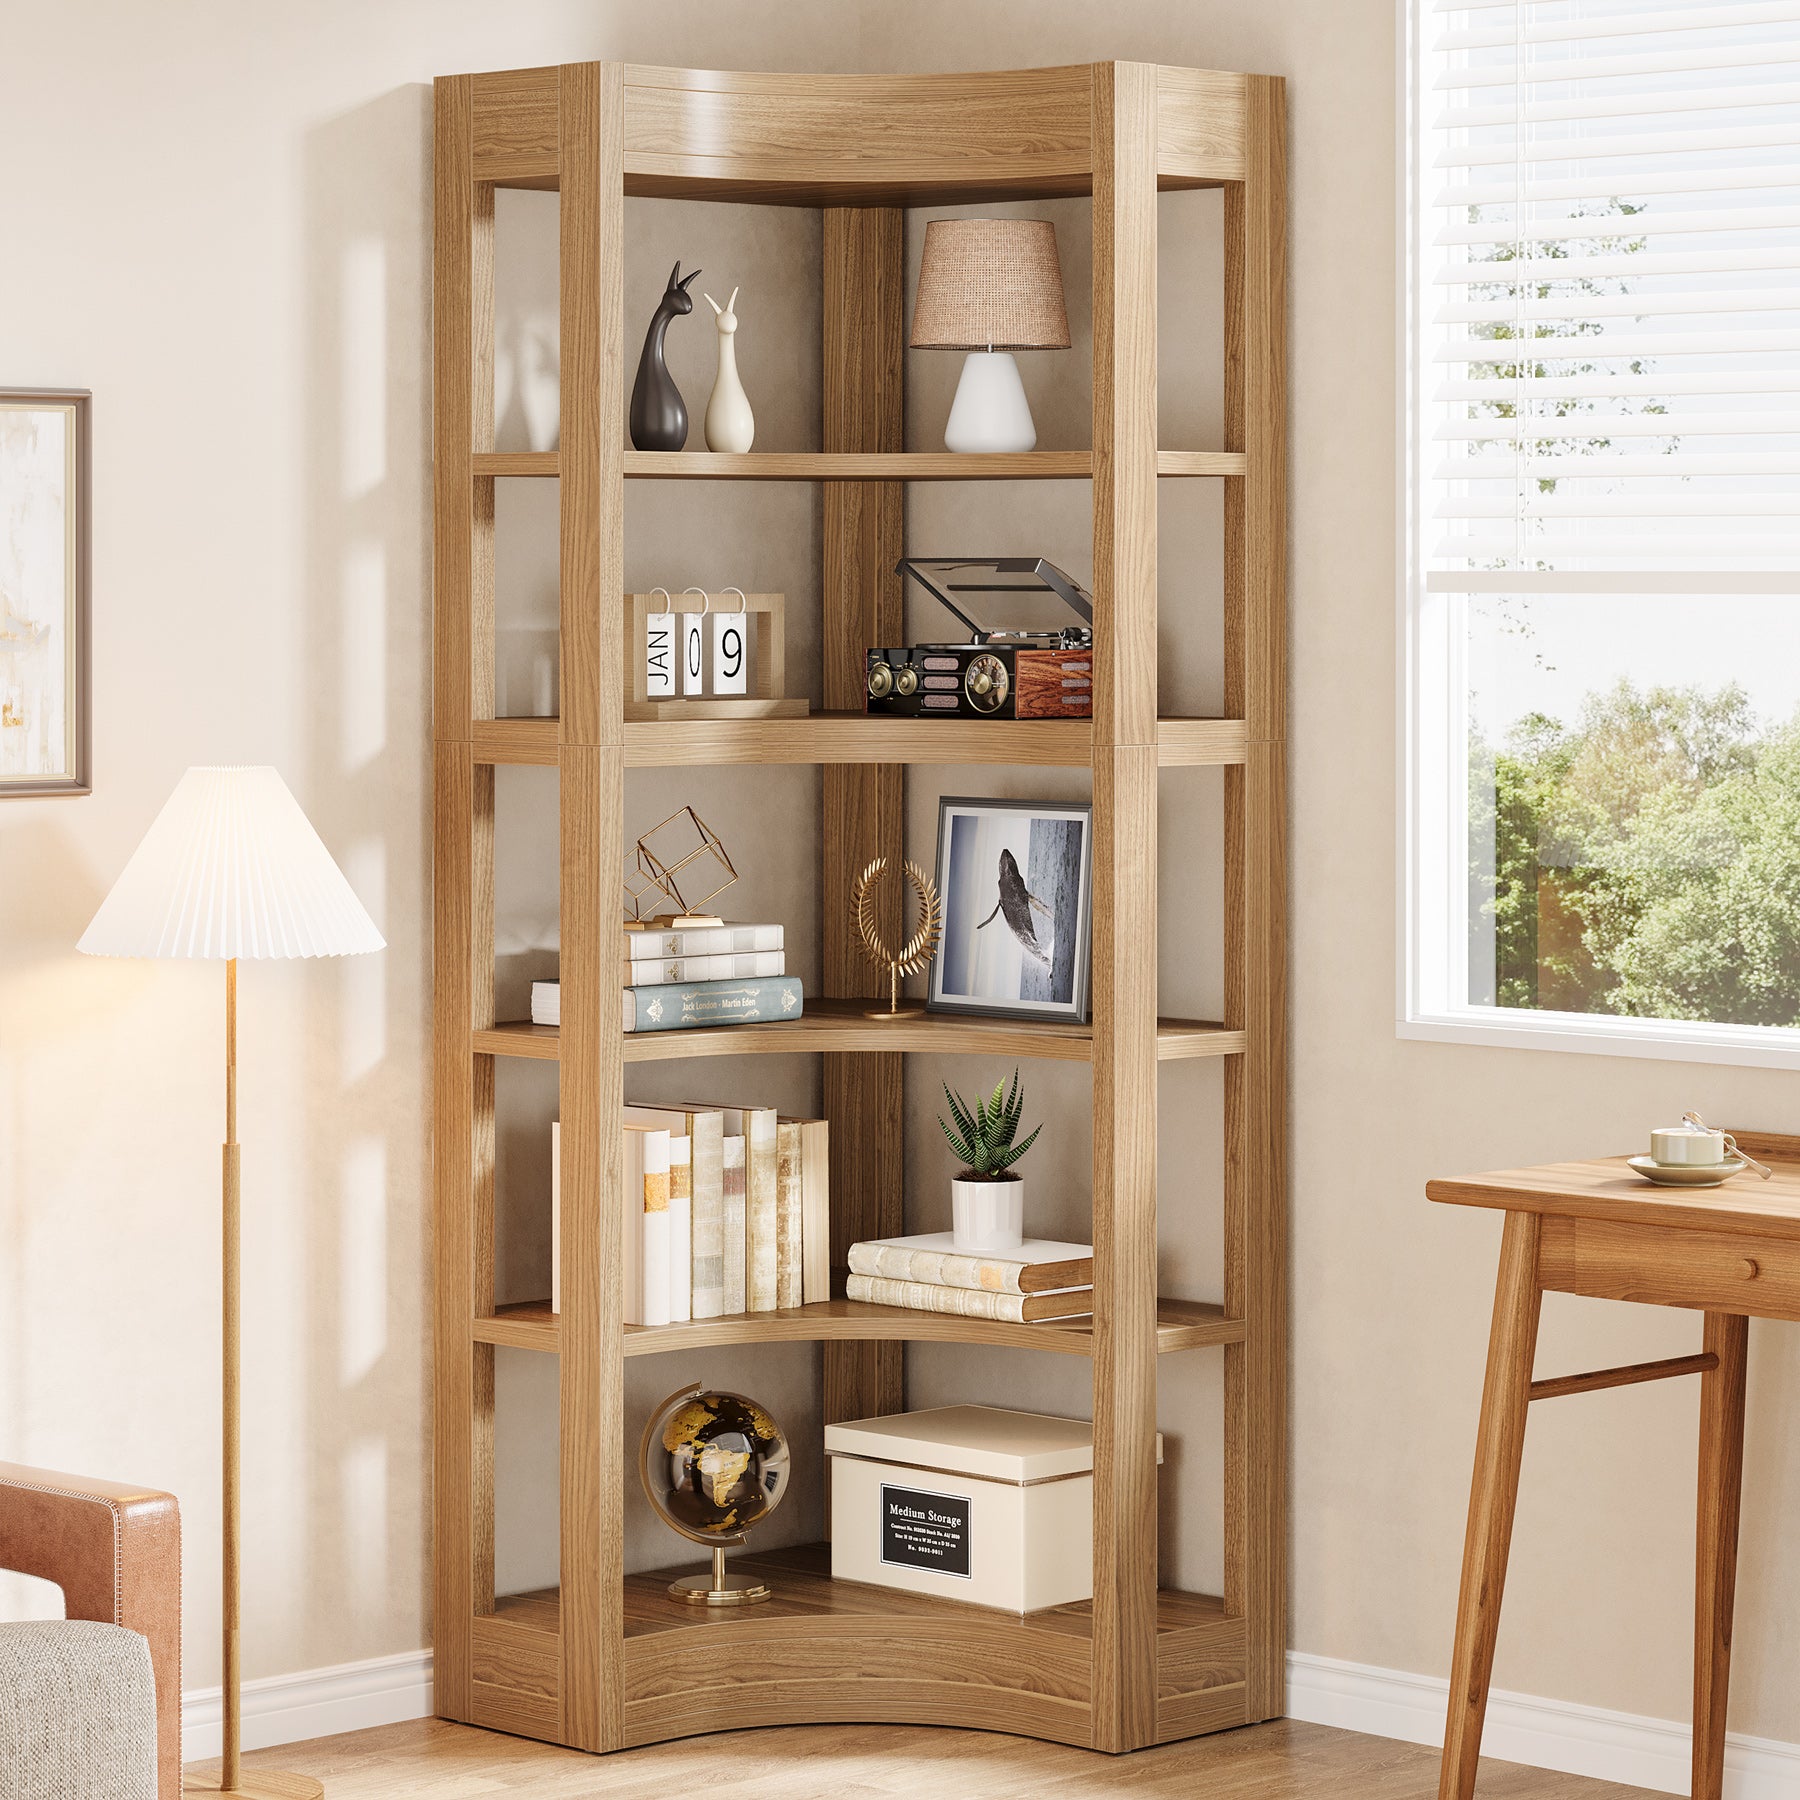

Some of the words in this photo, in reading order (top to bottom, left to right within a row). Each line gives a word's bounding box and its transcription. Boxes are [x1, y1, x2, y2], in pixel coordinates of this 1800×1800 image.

[648, 631, 668, 686] JAN
[722, 628, 742, 678] 9
[682, 1002, 695, 1012] Jack
[696, 1000, 717, 1010] London
[722, 998, 741, 1008] Martin
[742, 997, 756, 1007] Eden
[890, 1504, 925, 1520] Medium
[928, 1510, 962, 1528] Storage
